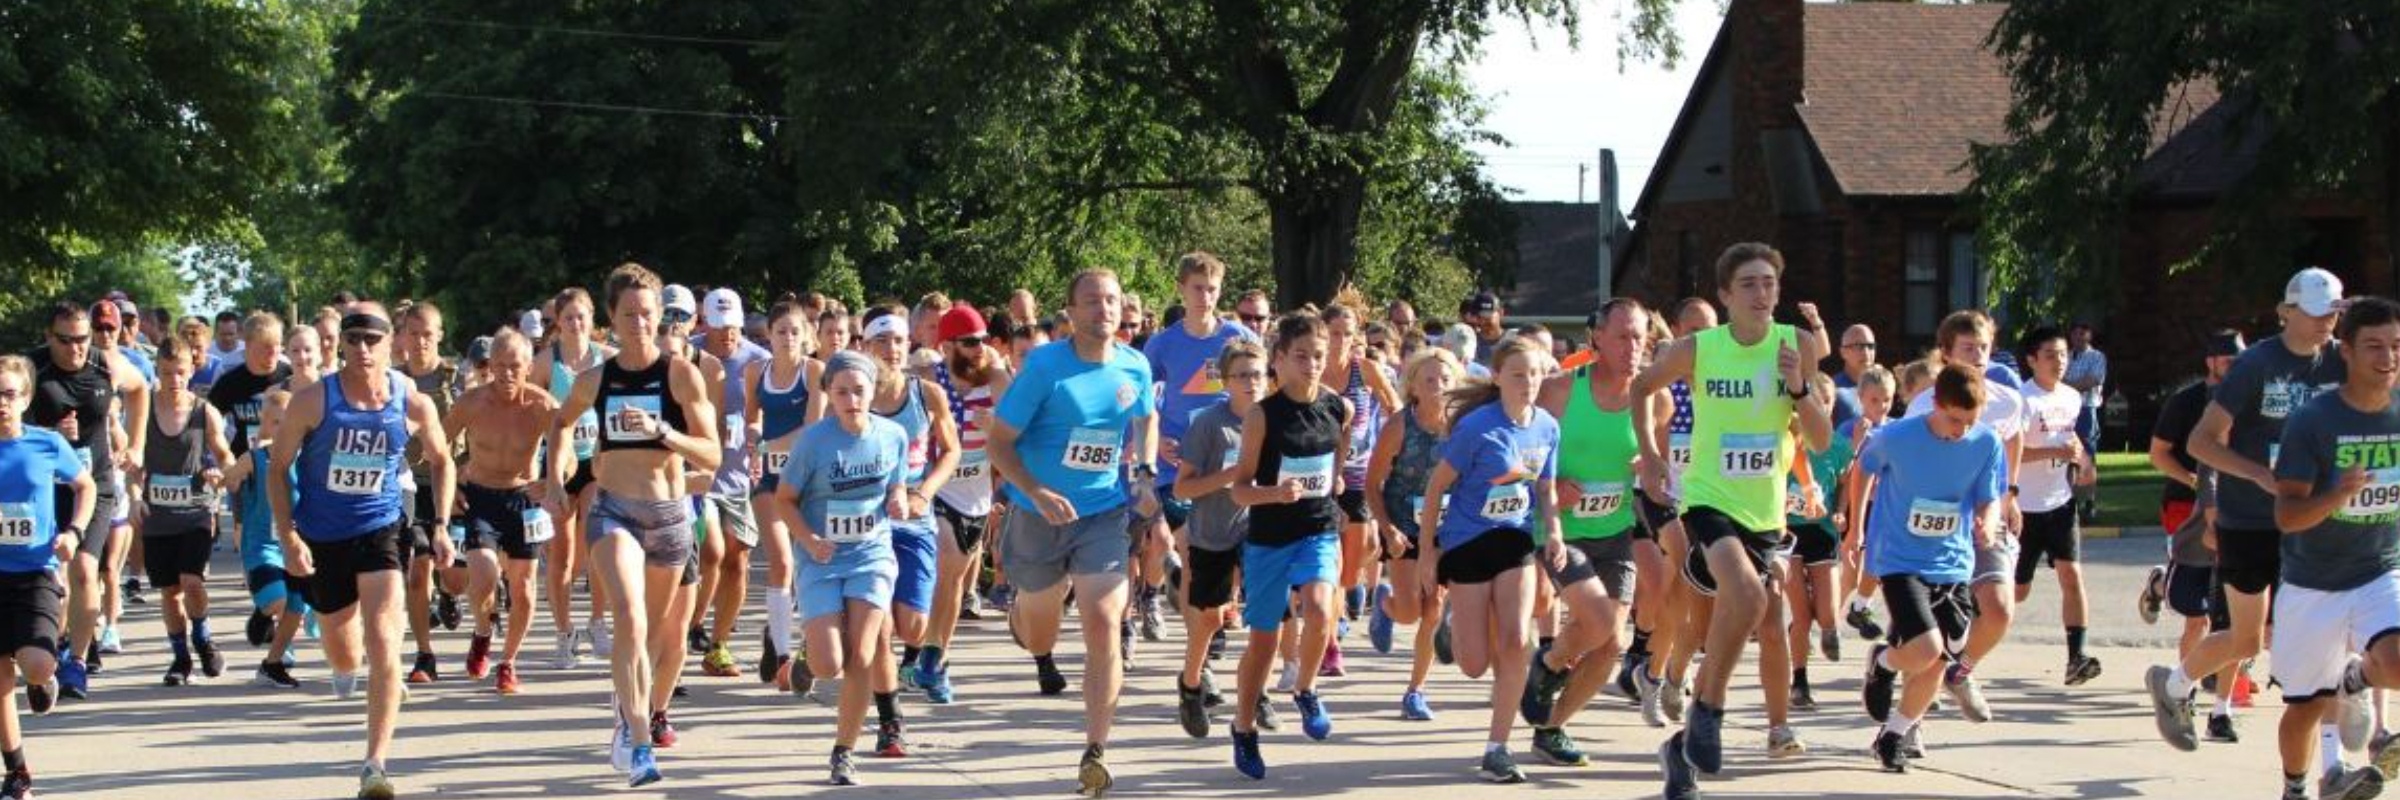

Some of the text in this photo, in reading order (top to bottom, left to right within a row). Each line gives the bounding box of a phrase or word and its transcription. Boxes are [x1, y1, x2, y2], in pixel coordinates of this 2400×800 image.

[1706, 379, 1754, 398] PELLA
[335, 427, 386, 455] USA
[1069, 445, 1113, 465] 1385
[1724, 452, 1773, 470] 1164
[332, 469, 381, 488] 1317
[1289, 475, 1327, 491] 082
[152, 486, 188, 501] 1071
[1580, 494, 1619, 511] 1270
[829, 515, 875, 535] 1119
[1913, 513, 1956, 530] 1381
